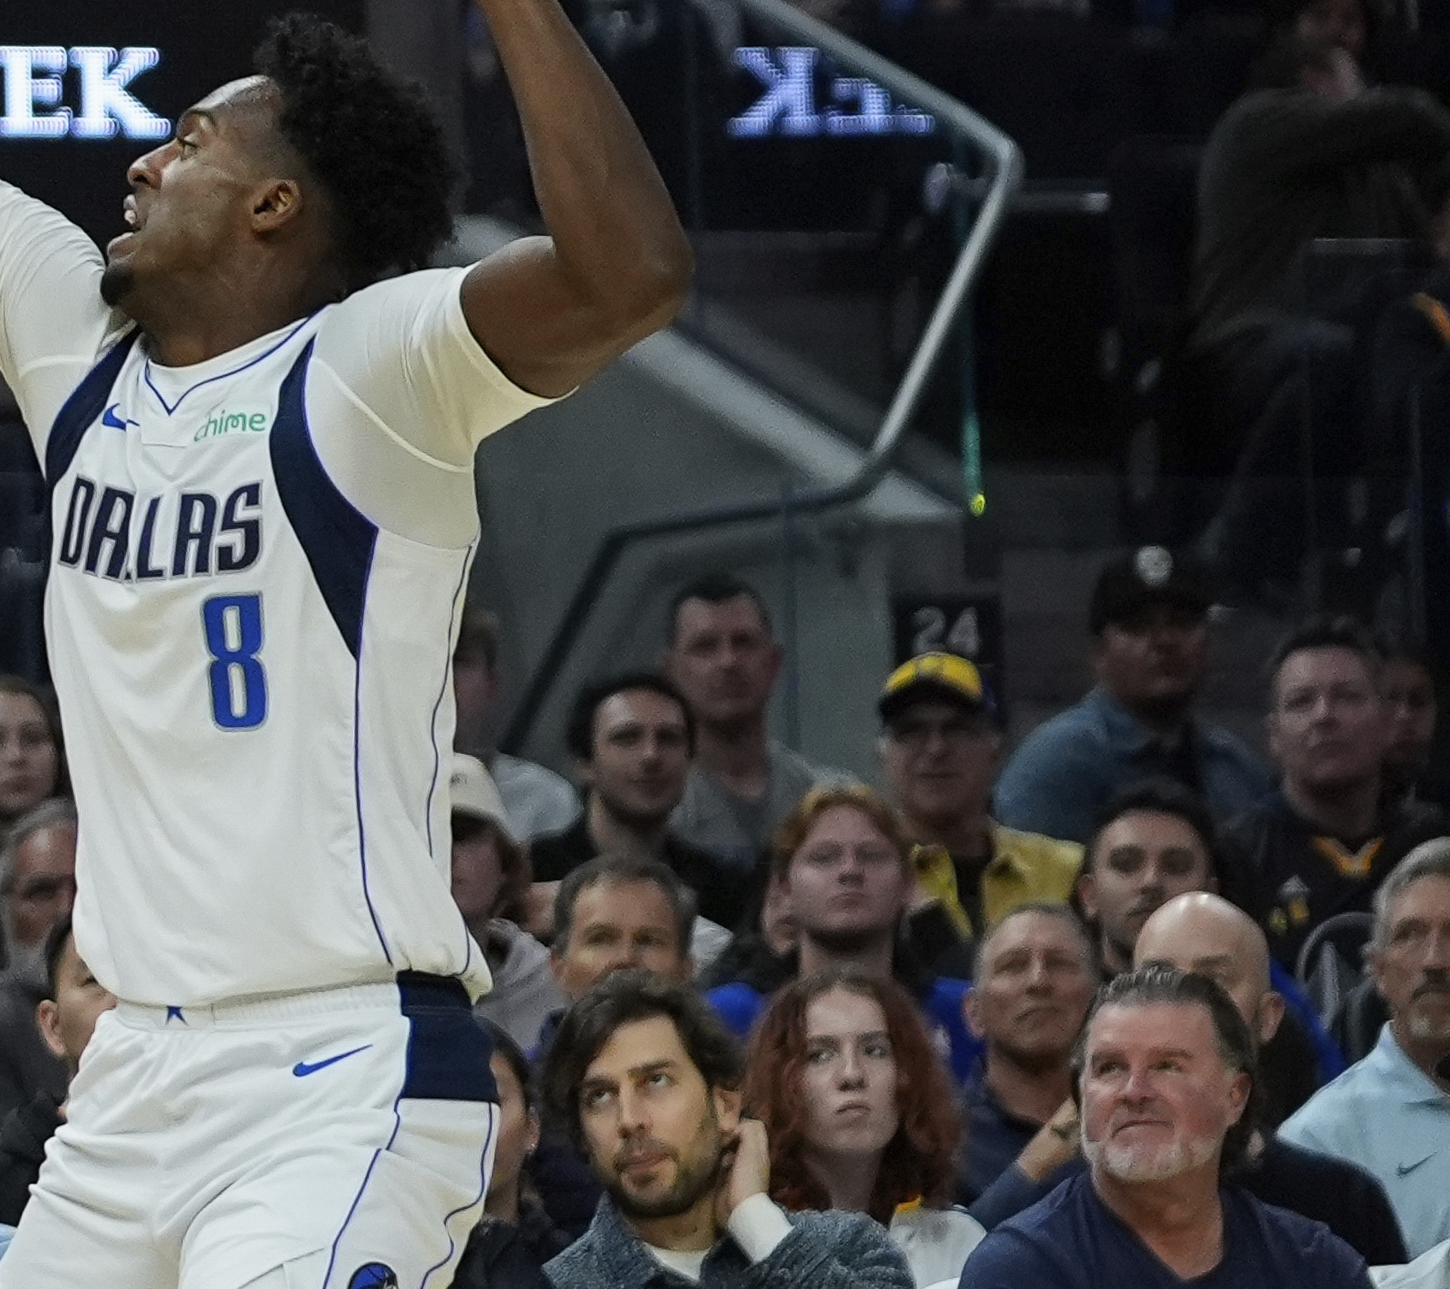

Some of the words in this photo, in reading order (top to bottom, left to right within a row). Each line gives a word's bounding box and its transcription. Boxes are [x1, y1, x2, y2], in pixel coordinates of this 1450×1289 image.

[194, 410, 265, 442] chime
[911, 605, 980, 657] 24
[202, 592, 268, 731] 8
